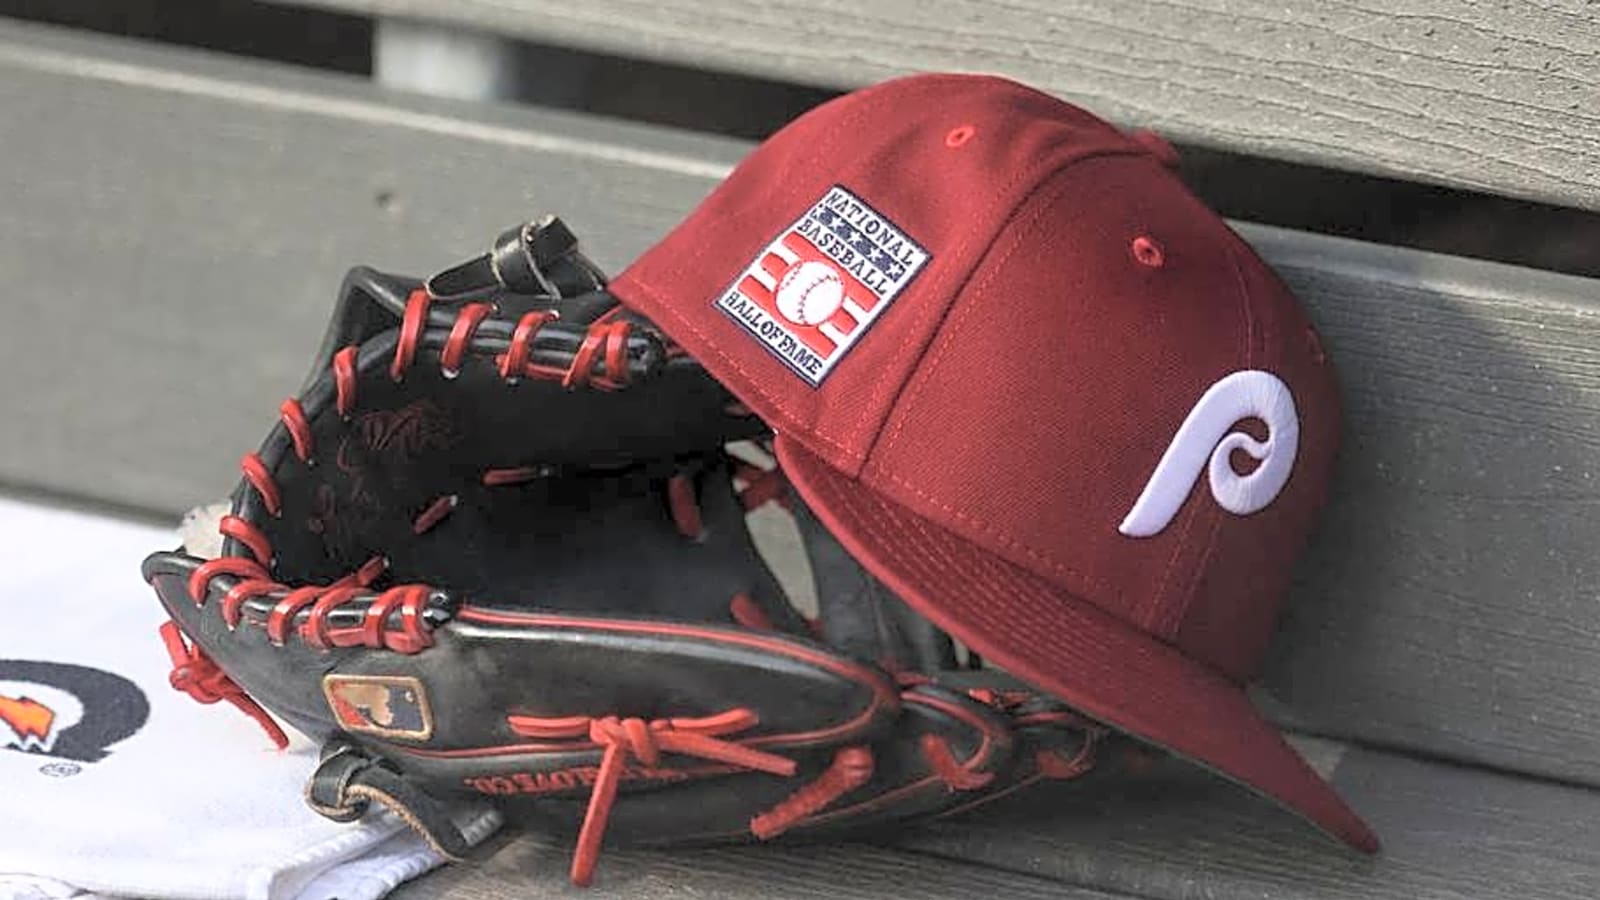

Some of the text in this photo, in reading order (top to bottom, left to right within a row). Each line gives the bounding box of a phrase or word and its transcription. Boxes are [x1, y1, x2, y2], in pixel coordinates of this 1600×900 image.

[798, 219, 889, 295] BASEBALL
[825, 191, 914, 266] NATIONAL
[725, 291, 823, 376] HALL OF FAME
[1118, 370, 1299, 536] P
